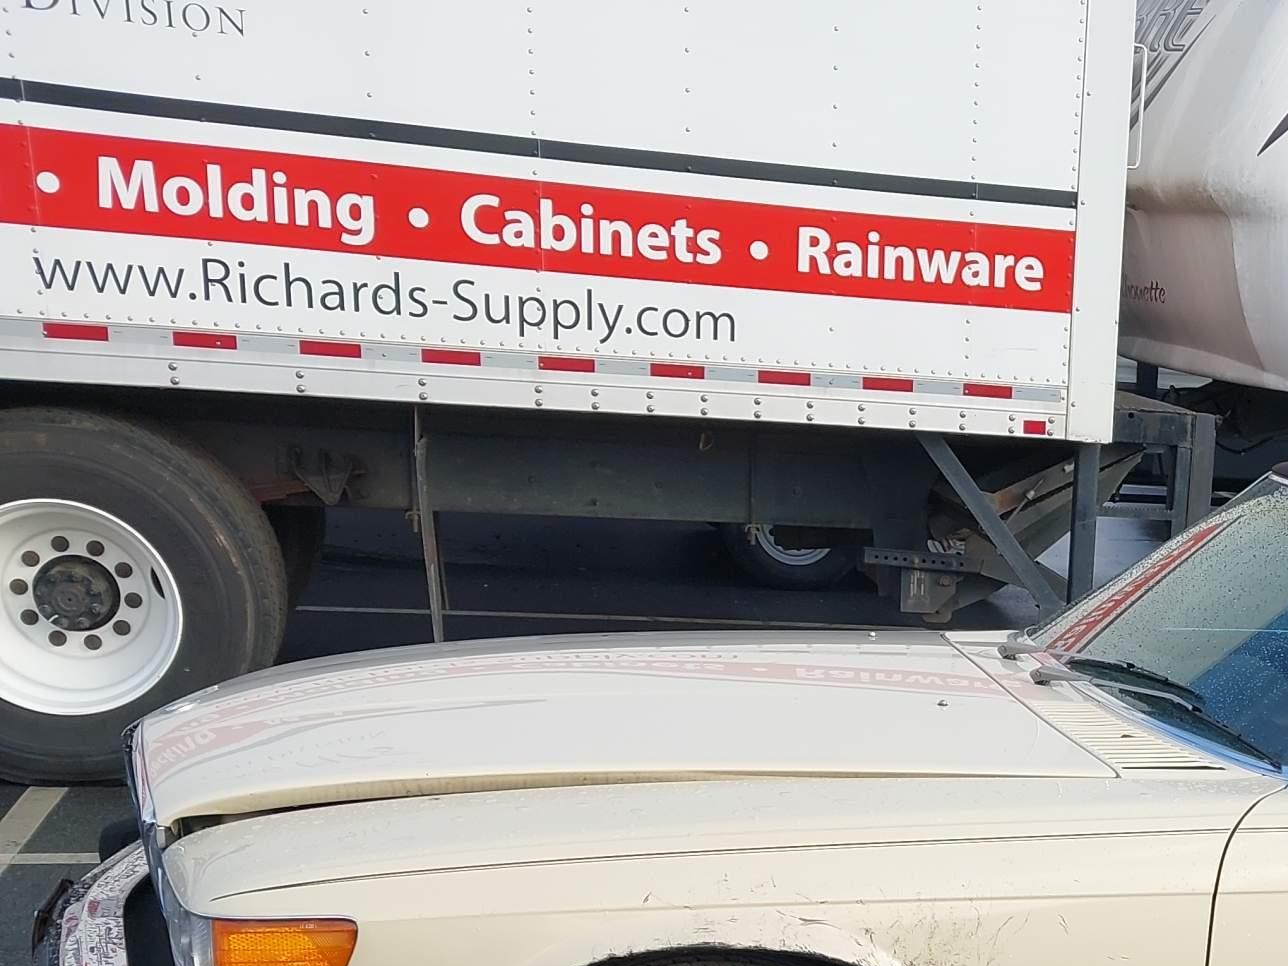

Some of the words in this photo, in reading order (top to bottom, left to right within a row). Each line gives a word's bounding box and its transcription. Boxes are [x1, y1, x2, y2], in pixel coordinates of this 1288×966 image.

[97, 156, 376, 246] Molding
[460, 194, 722, 266] Cabinets
[797, 227, 1044, 292] Rainware
[33, 257, 737, 345] www.Richards-Supply.com
